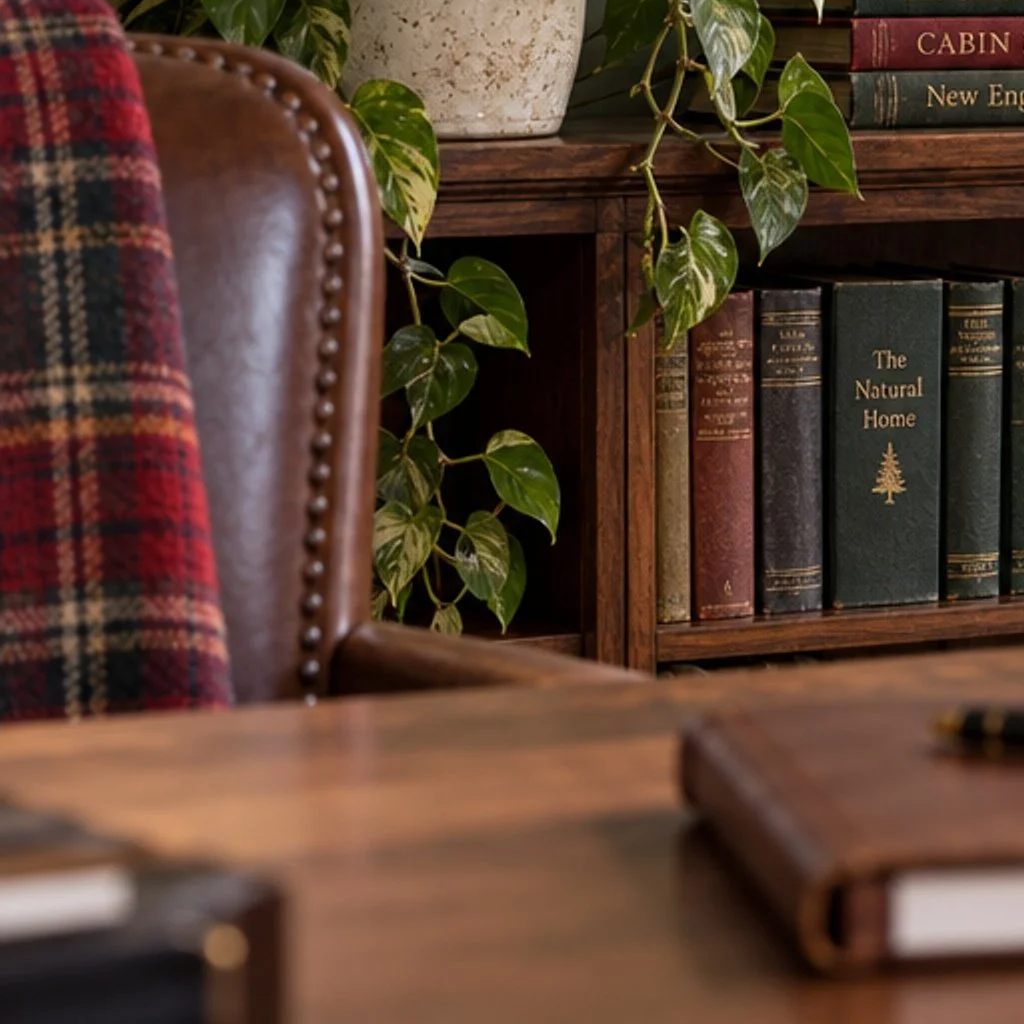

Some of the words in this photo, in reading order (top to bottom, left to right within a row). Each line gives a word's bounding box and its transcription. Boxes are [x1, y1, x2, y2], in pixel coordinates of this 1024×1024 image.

[917, 31, 1011, 56] CABIN
[926, 83, 978, 108] New
[873, 349, 907, 370] The
[855, 376, 924, 401] Natural
[862, 409, 917, 430] Home
